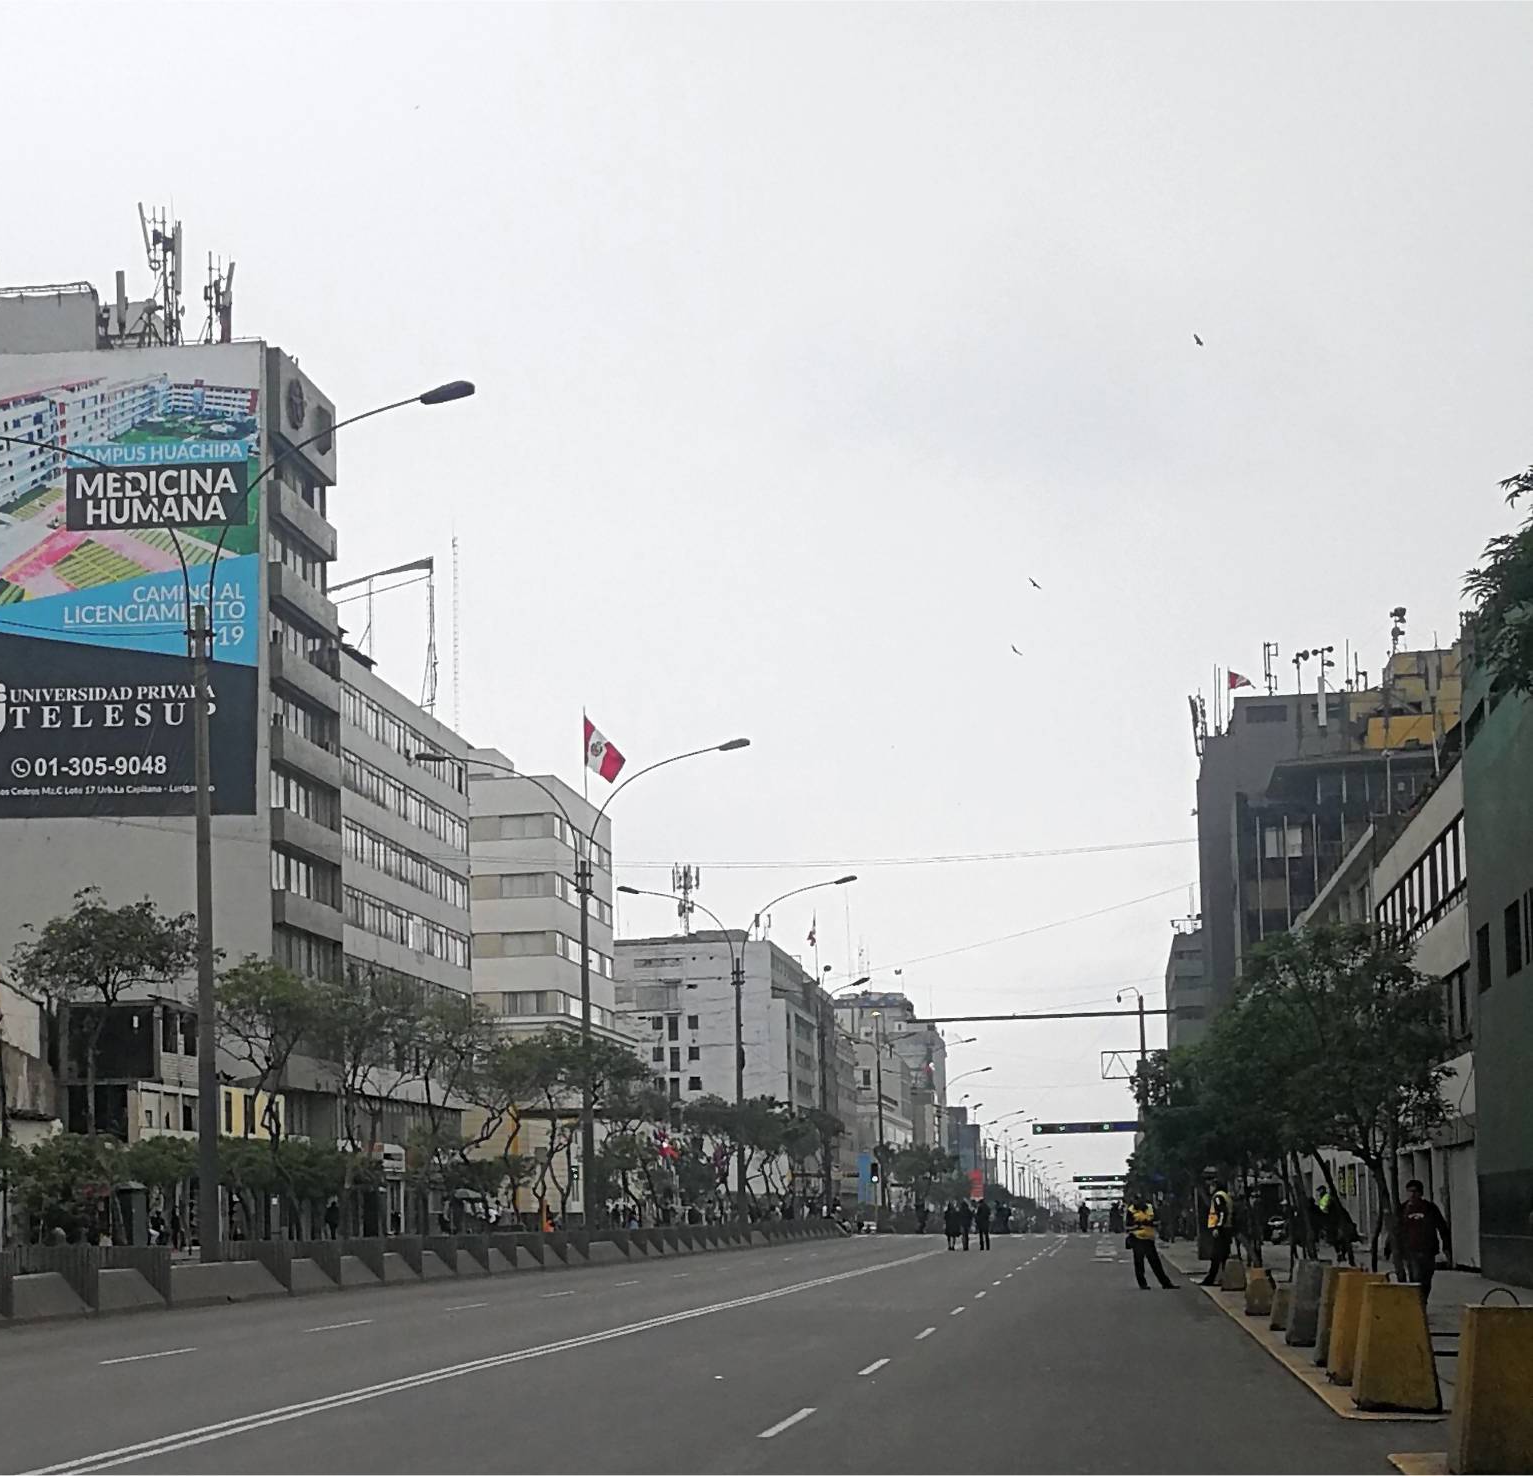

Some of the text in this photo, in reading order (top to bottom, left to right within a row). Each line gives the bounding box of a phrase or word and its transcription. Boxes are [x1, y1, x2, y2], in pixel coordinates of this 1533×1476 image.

[72, 443, 243, 464] CAMPUS HUACHIPA
[75, 468, 238, 499] MEDICINA
[86, 495, 227, 525] HUMANA
[133, 583, 245, 602] CAMINO AL
[10, 686, 133, 703] UNIVERSIDAD
[34, 756, 167, 777] 01-305-9048
[85, 785, 96, 795] 17
